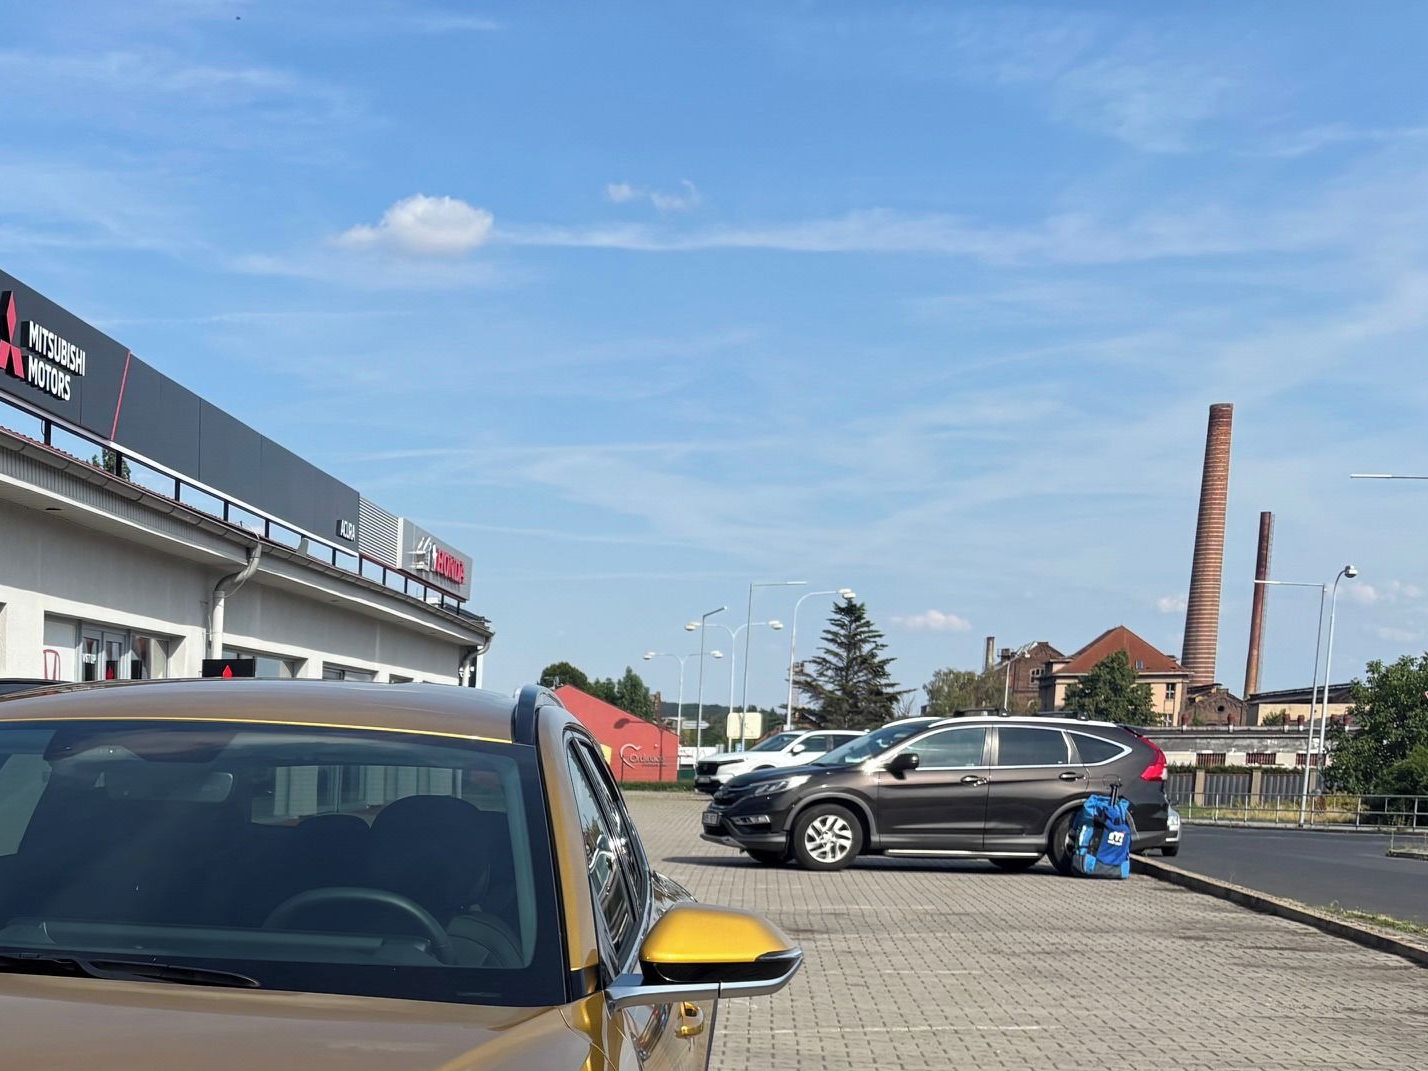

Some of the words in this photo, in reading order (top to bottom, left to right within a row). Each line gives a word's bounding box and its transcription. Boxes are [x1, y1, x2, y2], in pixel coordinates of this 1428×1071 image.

[28, 320, 86, 376] MITSUBISHI
[27, 355, 71, 401] MOTORS
[340, 519, 356, 542] ACURA
